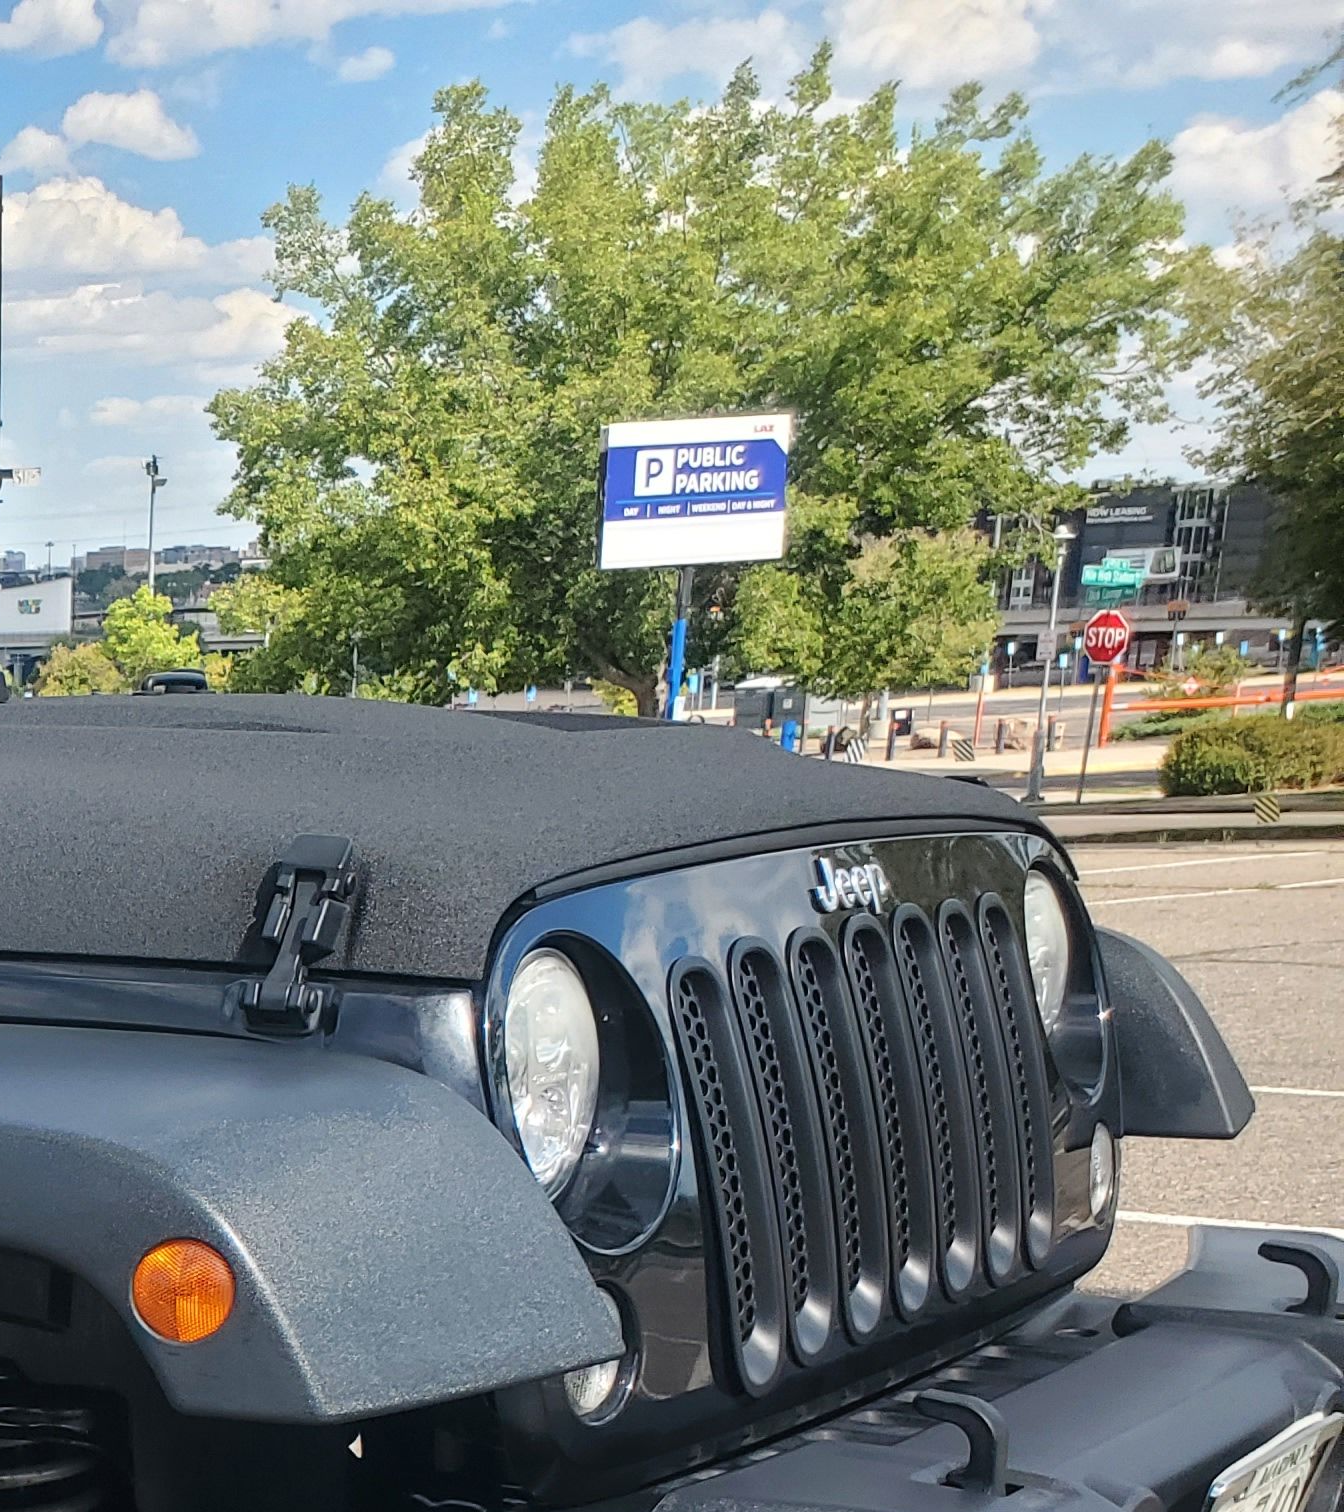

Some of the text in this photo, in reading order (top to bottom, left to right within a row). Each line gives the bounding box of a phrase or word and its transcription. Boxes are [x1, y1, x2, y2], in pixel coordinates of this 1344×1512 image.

[675, 445, 746, 469] PUBLIC
[674, 469, 760, 495] PARKING
[623, 507, 639, 517] DAY
[691, 501, 727, 513] WEEKEND
[731, 500, 747, 511] DAY
[1086, 626, 1126, 649] STOP
[808, 856, 889, 915] Jeep
